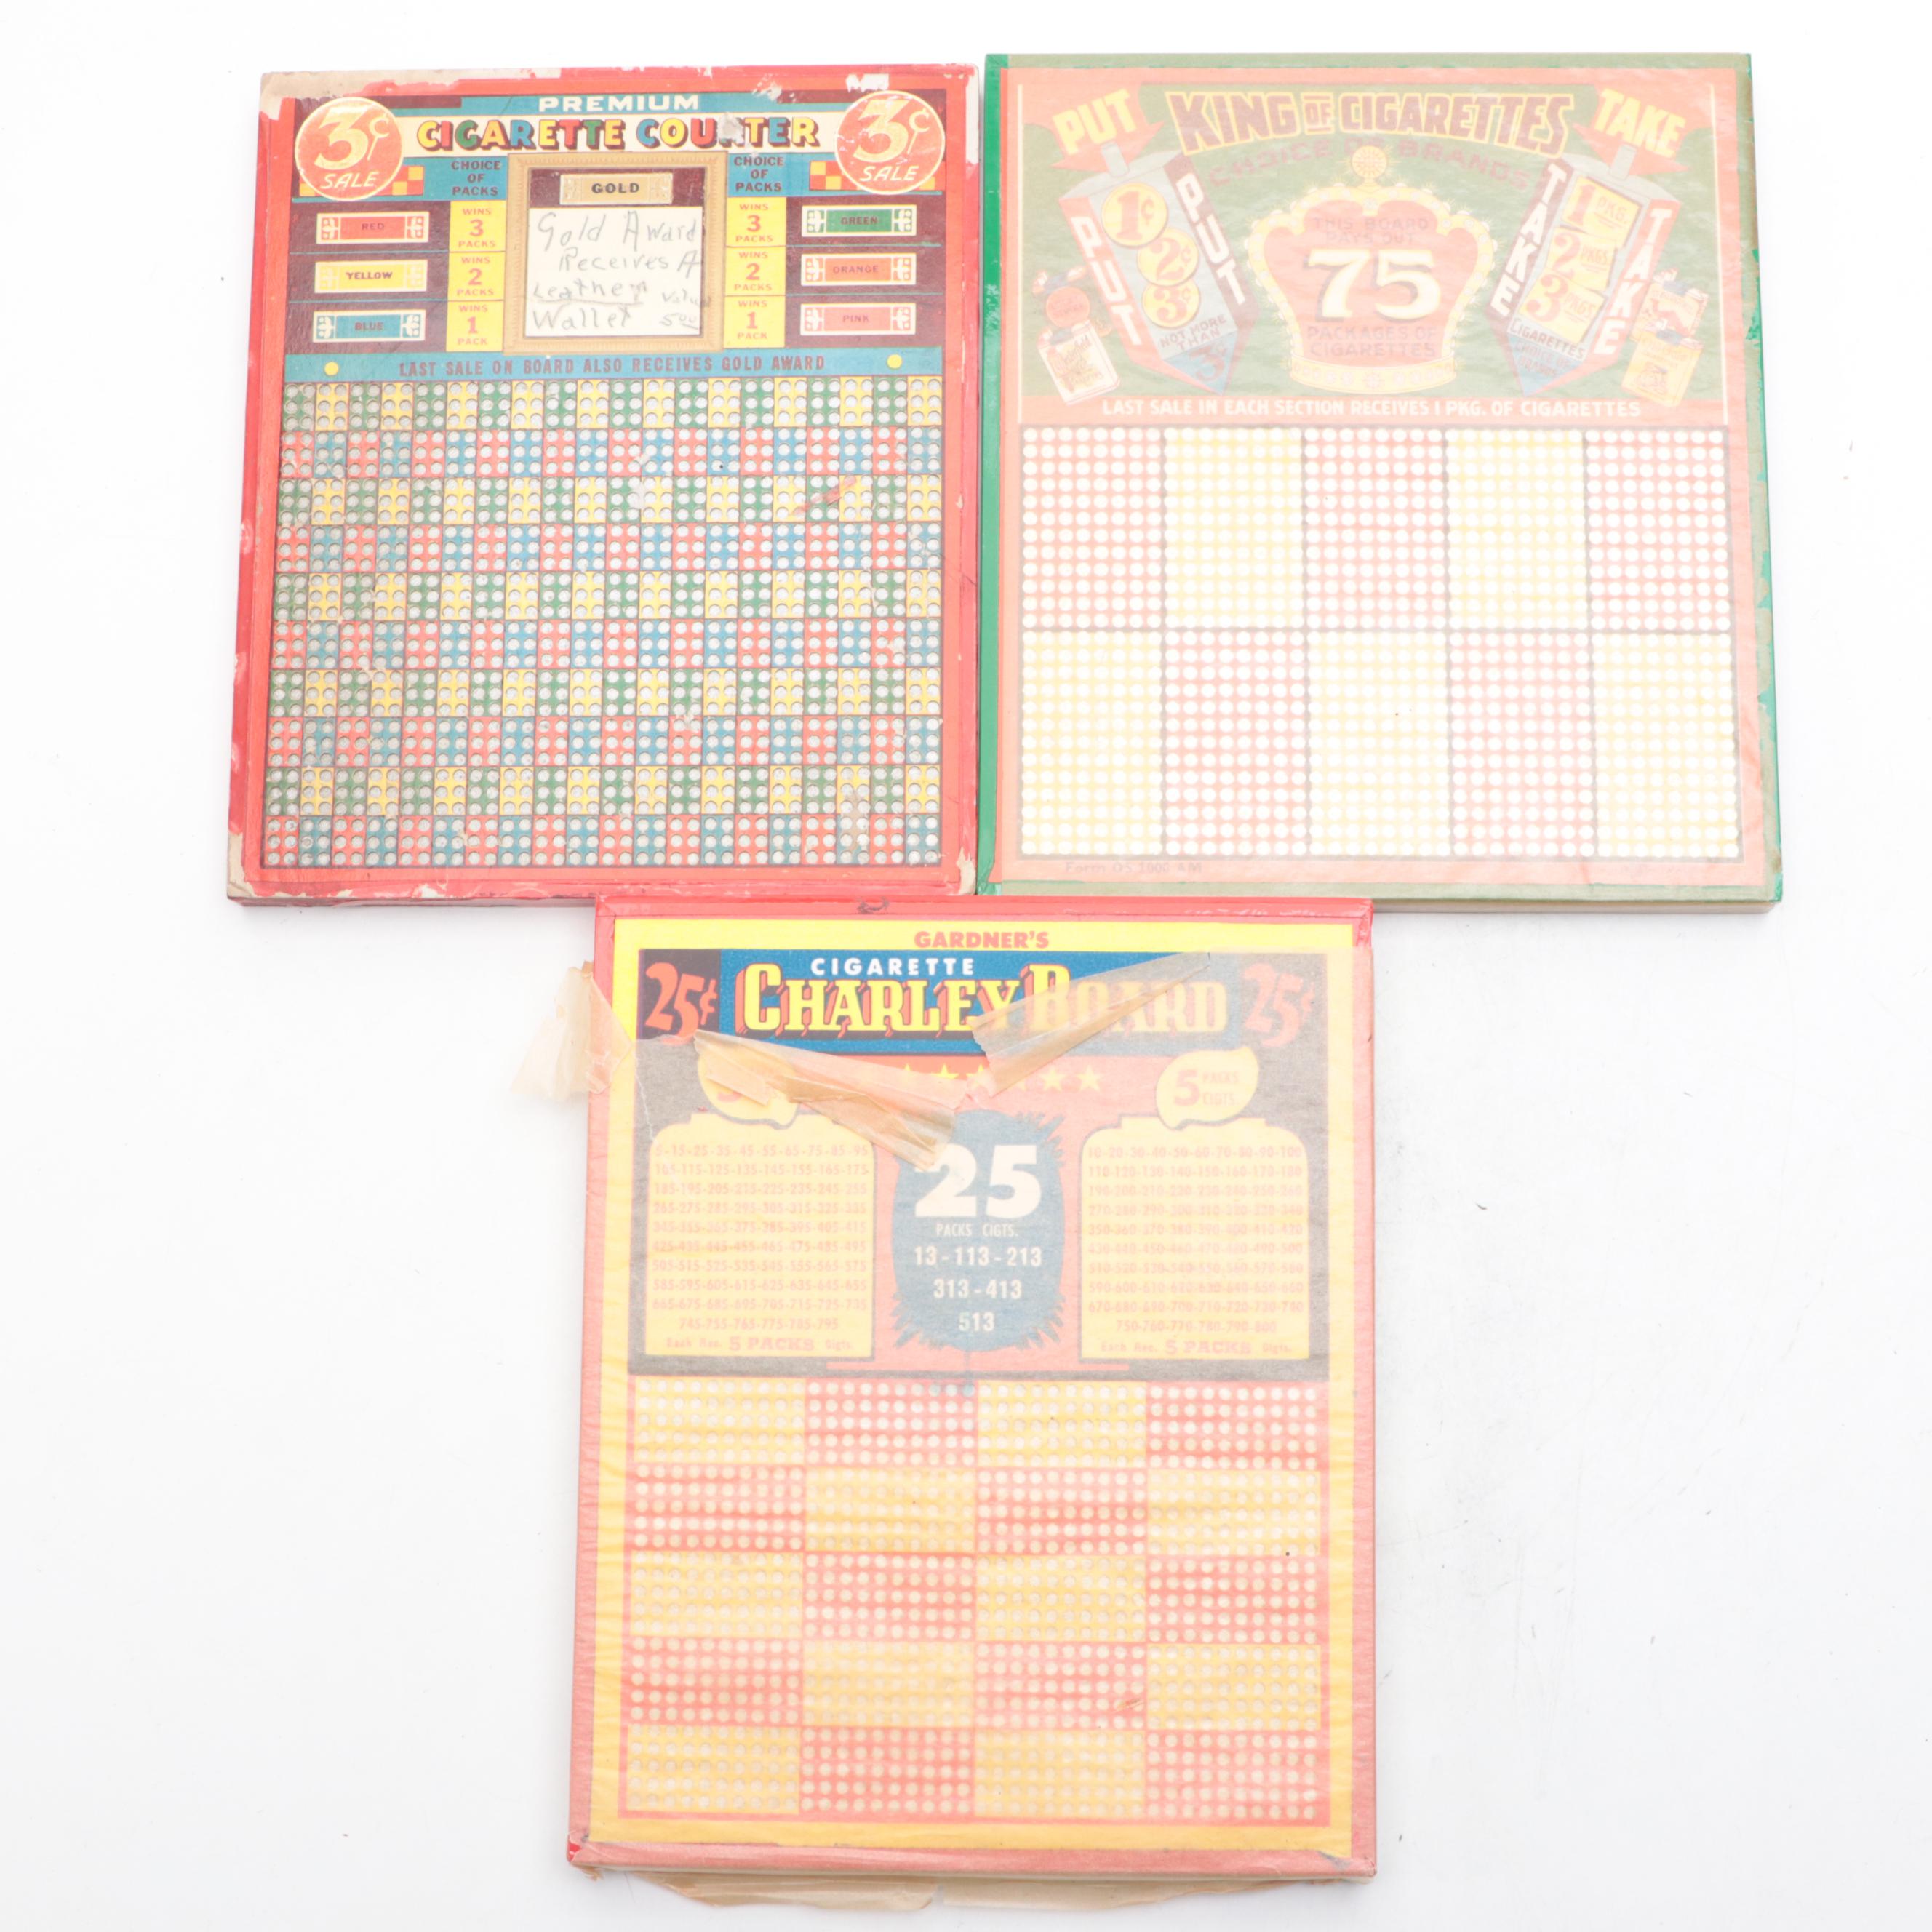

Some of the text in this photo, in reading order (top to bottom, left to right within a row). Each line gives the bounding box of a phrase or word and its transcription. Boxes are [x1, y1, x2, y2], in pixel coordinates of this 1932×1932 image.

[538, 94, 699, 113] PREMIUM
[1052, 89, 1139, 156] PUT
[1165, 91, 1574, 157] KING OF CIGARETTES
[1592, 88, 1685, 157] TAKE
[417, 118, 626, 151] CIGARETTE
[451, 160, 501, 171] CHOICE
[734, 156, 784, 167] CHOICE
[1209, 139, 1330, 186] CHOICE
[1397, 137, 1531, 189] BRANDS
[320, 172, 379, 190] SALE
[467, 173, 485, 183] OF
[750, 169, 768, 180] OF
[860, 165, 919, 183] SALE
[452, 185, 498, 196] PACKS
[591, 182, 640, 194] GOLD
[735, 182, 782, 193] PACKS
[462, 208, 492, 216] WINS
[739, 203, 770, 211] WINS
[1567, 184, 1597, 227] 1
[362, 223, 385, 231] RED
[469, 220, 484, 237] 3
[746, 215, 762, 233] 3
[840, 216, 878, 225] GREEN
[1314, 217, 1429, 231] THIS BOARD
[538, 210, 697, 252] Gold Award
[735, 234, 774, 243] PACKS
[1326, 231, 1415, 245] PAYS OUT
[458, 239, 496, 248] PACKS
[1175, 173, 1246, 306] PUT
[1490, 163, 1568, 317] TAKE
[460, 256, 490, 265] WINS
[559, 246, 700, 279] Receives A
[738, 251, 769, 259] WINS
[1552, 231, 1581, 280] 2
[346, 271, 393, 280] YELLOW
[468, 268, 483, 285] 2
[746, 263, 761, 280] 2
[832, 264, 879, 274] ORANGE
[733, 283, 773, 292] PACKS
[1070, 216, 1142, 346] PUT
[1309, 249, 1441, 320] 75
[1594, 208, 1672, 354] TAKE
[456, 288, 495, 297] PACKS
[1526, 274, 1568, 322] 3
[458, 304, 489, 313] WINS
[738, 300, 768, 308] WINS
[467, 317, 478, 333] 1
[533, 306, 631, 330] Wallet
[746, 312, 758, 328] 1
[842, 314, 870, 323] PINK
[354, 322, 384, 331] BLUE
[1159, 314, 1226, 348] NOT MORE
[1306, 325, 1437, 341] PACKAGES OF
[457, 337, 488, 346] PACK
[737, 332, 768, 340] PACK
[1178, 327, 1221, 350] THAN
[1509, 317, 1585, 359] CIGARETTES
[1309, 343, 1436, 357] CIGARETTES
[399, 355, 825, 378] LAST SALE ON BOARD ALSO RECEIVES GOLD AWARD
[1103, 400, 1144, 415] LAST
[1151, 399, 1192, 415] SALE
[1199, 399, 1217, 415] IN
[1224, 399, 1269, 415] EACH
[1274, 399, 1344, 415] SECTION
[1351, 399, 1429, 415] RECEIVES
[1445, 400, 1488, 416] PKG.
[1491, 400, 1514, 416] OF
[1520, 400, 1642, 417] CIGARETTES
[914, 930, 1049, 949] GARDNER'S
[810, 957, 975, 975] CIGARETTE
[736, 962, 1228, 1034] CHARLEY BOARD
[1174, 1069, 1200, 1106] 5
[914, 1143, 1042, 1218] 25
[935, 1223, 973, 1237] PACKS
[959, 1312, 995, 1332] 513
[729, 1336, 741, 1351] 5
[747, 1338, 815, 1351] PACKS
[1165, 1340, 1178, 1354] 5
[1183, 1341, 1252, 1354] PACKS
